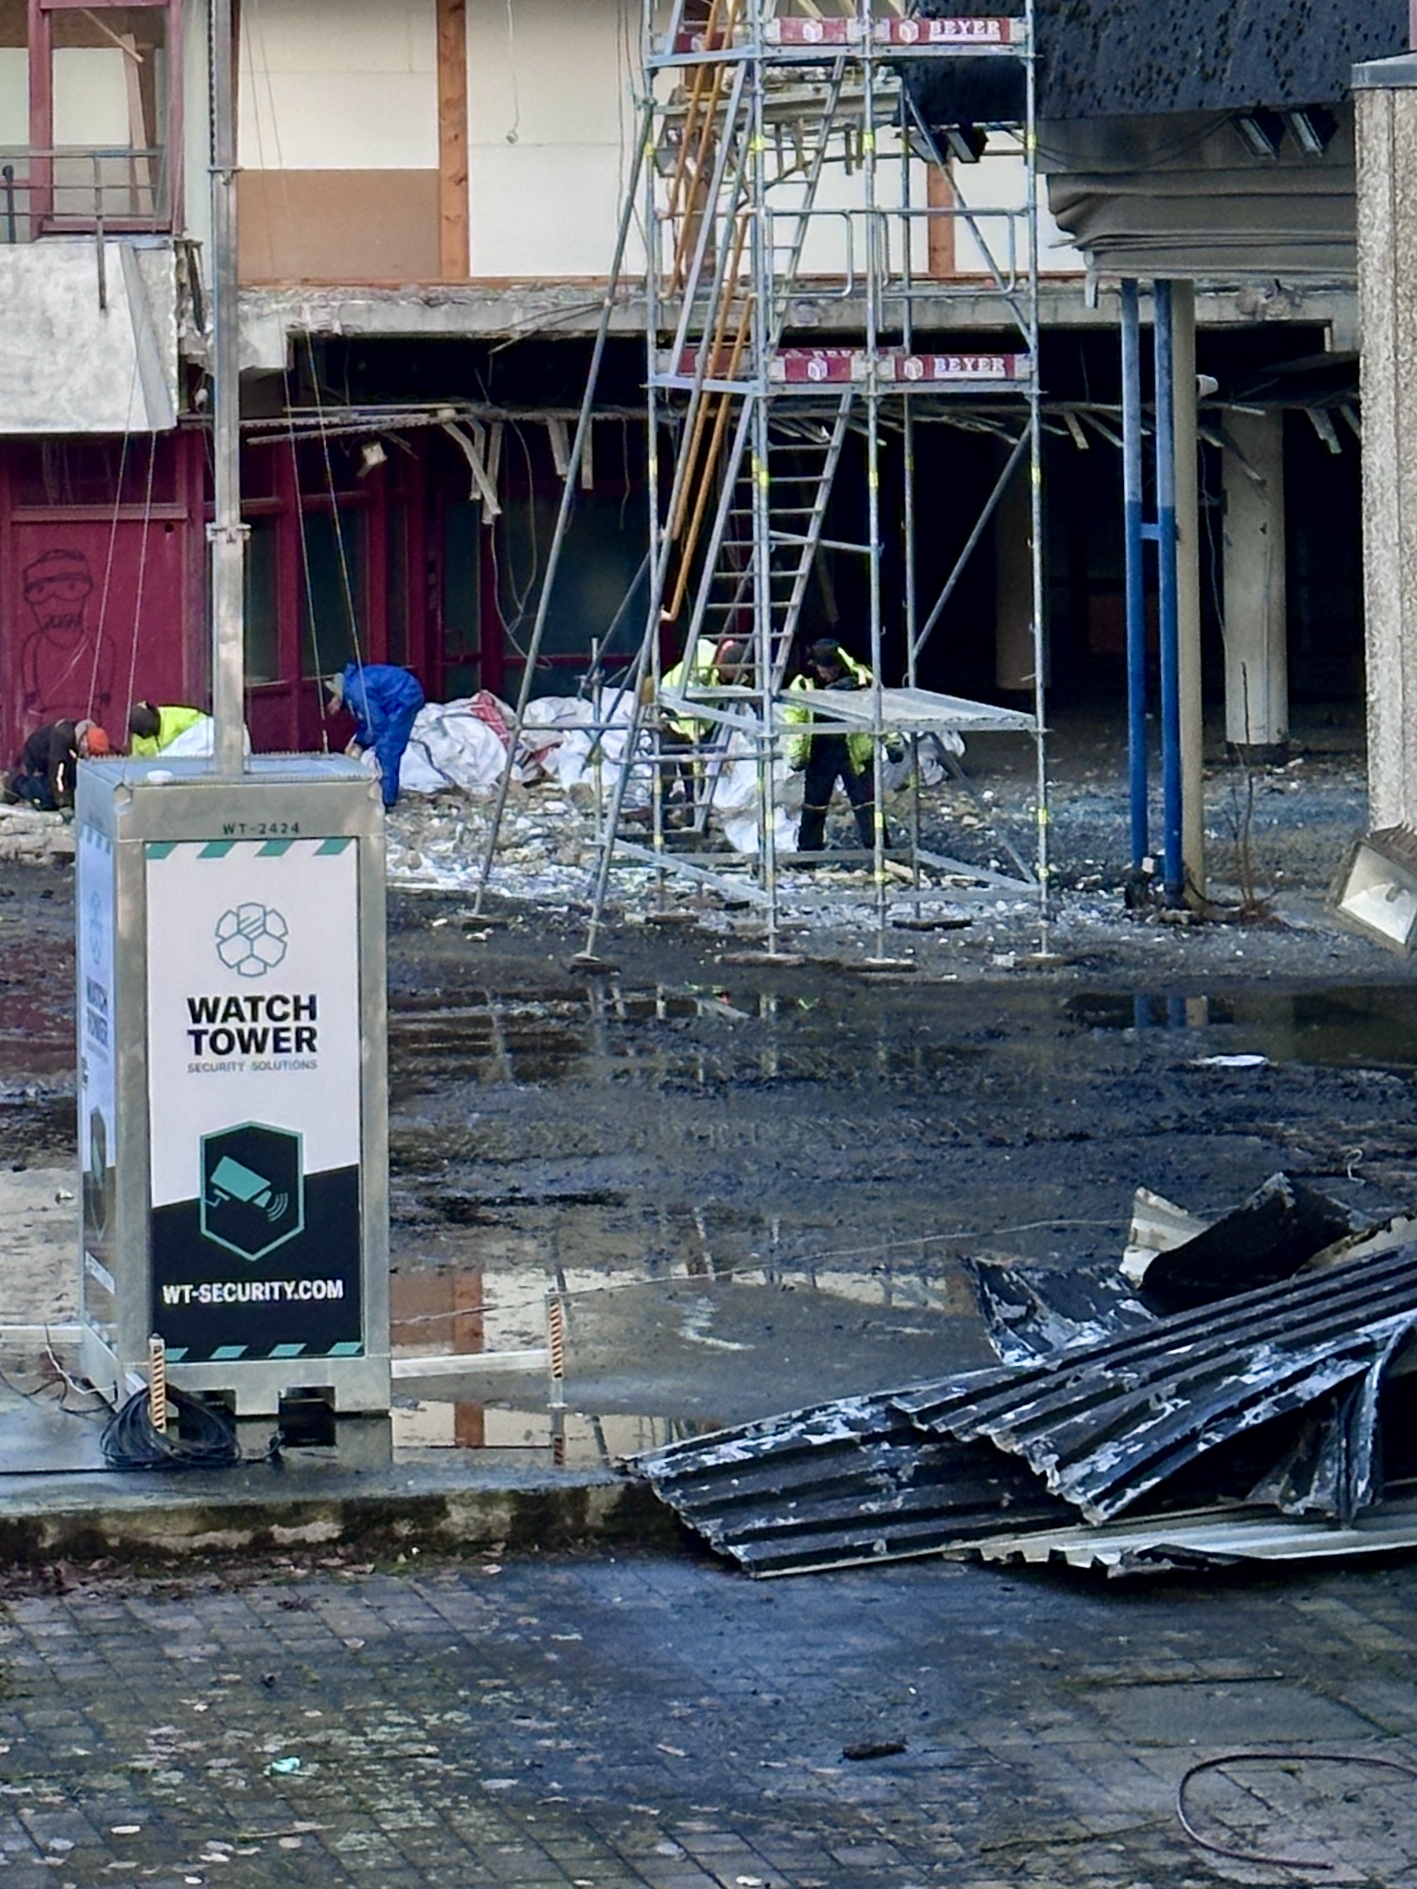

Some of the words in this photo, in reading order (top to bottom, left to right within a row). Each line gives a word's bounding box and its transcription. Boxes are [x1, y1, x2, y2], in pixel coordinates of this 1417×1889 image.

[929, 21, 1001, 36] BEYER
[934, 357, 1005, 372] BEYER
[223, 822, 300, 835] WT-2424
[187, 994, 317, 1024] WATCH
[187, 1026, 318, 1056] TOWER
[187, 1061, 245, 1073] SECURITY
[251, 1059, 318, 1071] SOLUTIONS
[162, 1279, 344, 1304] WT-SECURITY.COM
